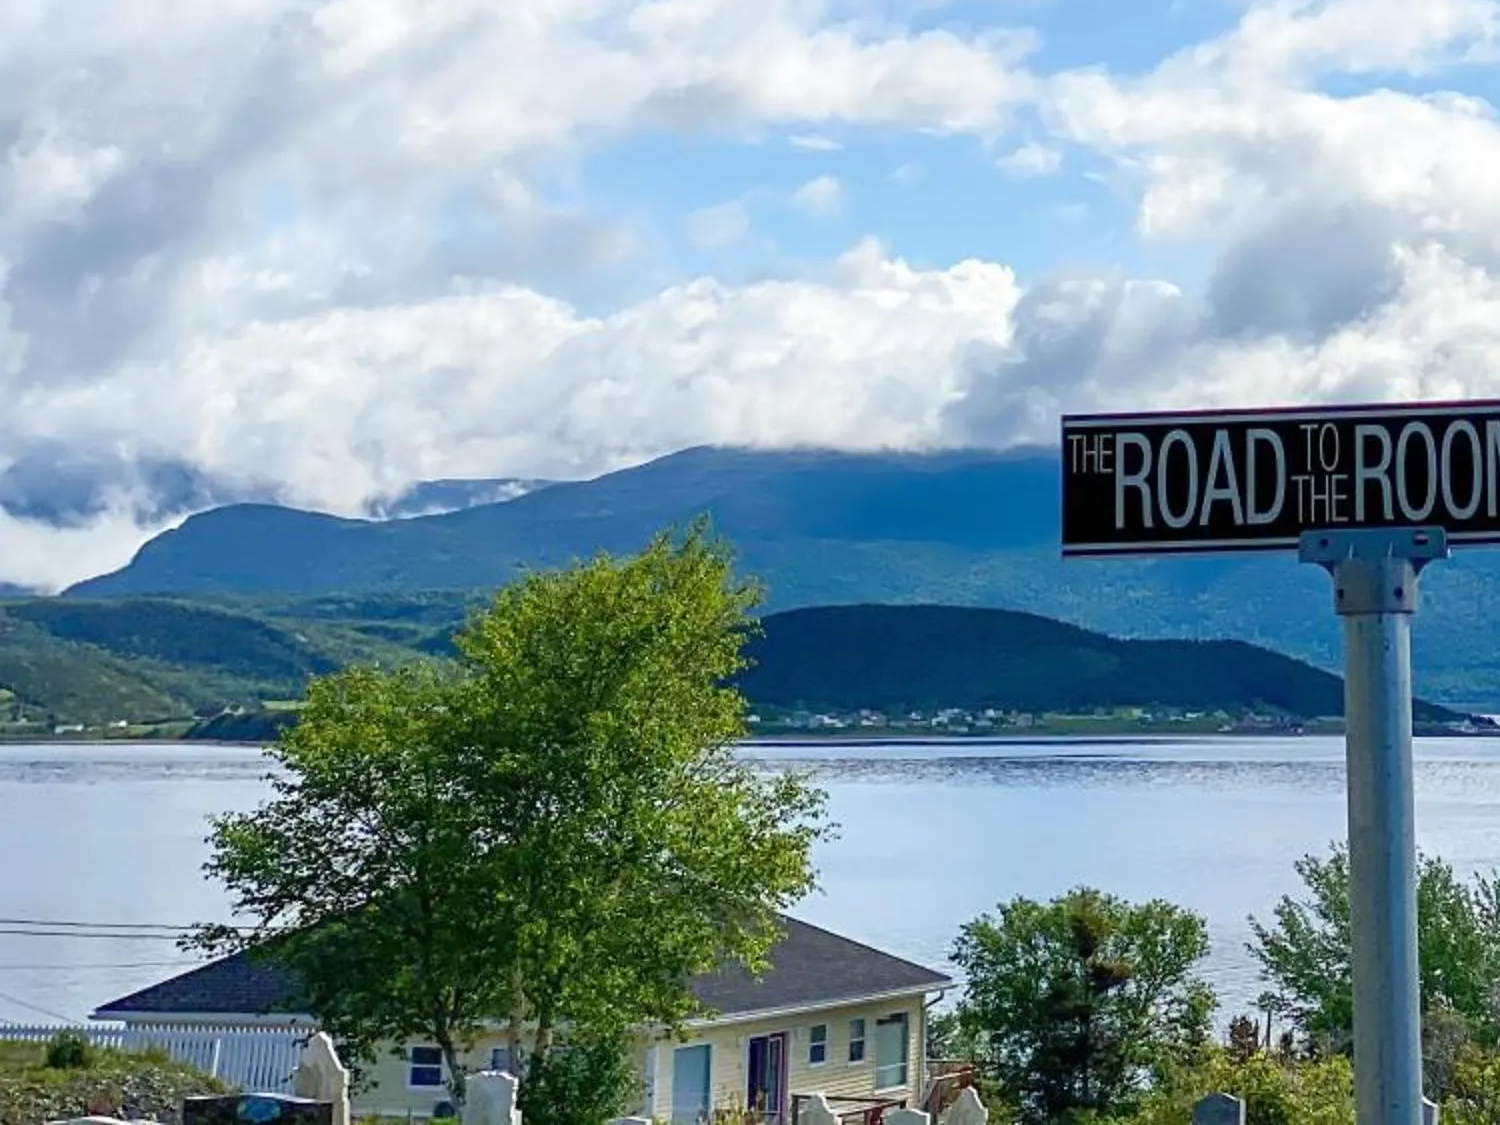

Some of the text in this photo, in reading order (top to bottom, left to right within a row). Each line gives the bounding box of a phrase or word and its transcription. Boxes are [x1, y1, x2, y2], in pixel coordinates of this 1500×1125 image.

[1300, 422, 1340, 472] TO
[1067, 427, 1287, 529] THE ROAD
[1291, 474, 1349, 524] THE
